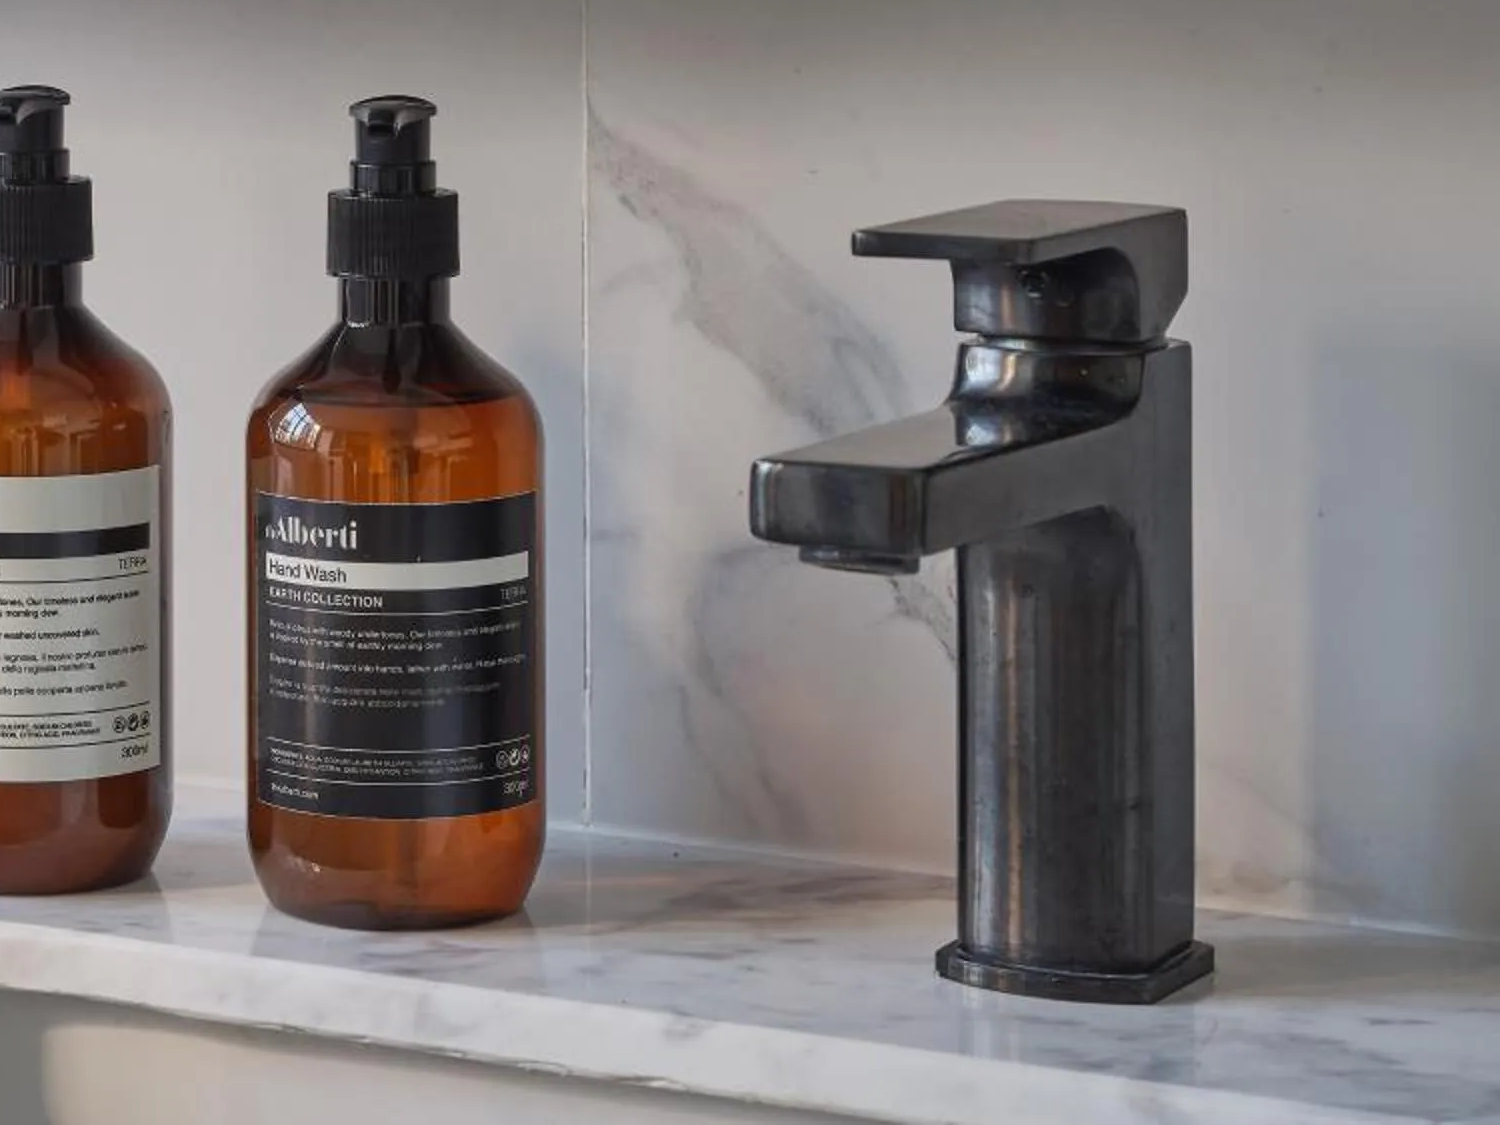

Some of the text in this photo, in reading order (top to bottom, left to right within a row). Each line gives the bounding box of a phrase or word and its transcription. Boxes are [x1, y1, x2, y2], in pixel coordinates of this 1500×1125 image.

[269, 558, 347, 584] Hand Wash
[269, 586, 301, 602] EARTH
[303, 592, 383, 608] COLLECTION
